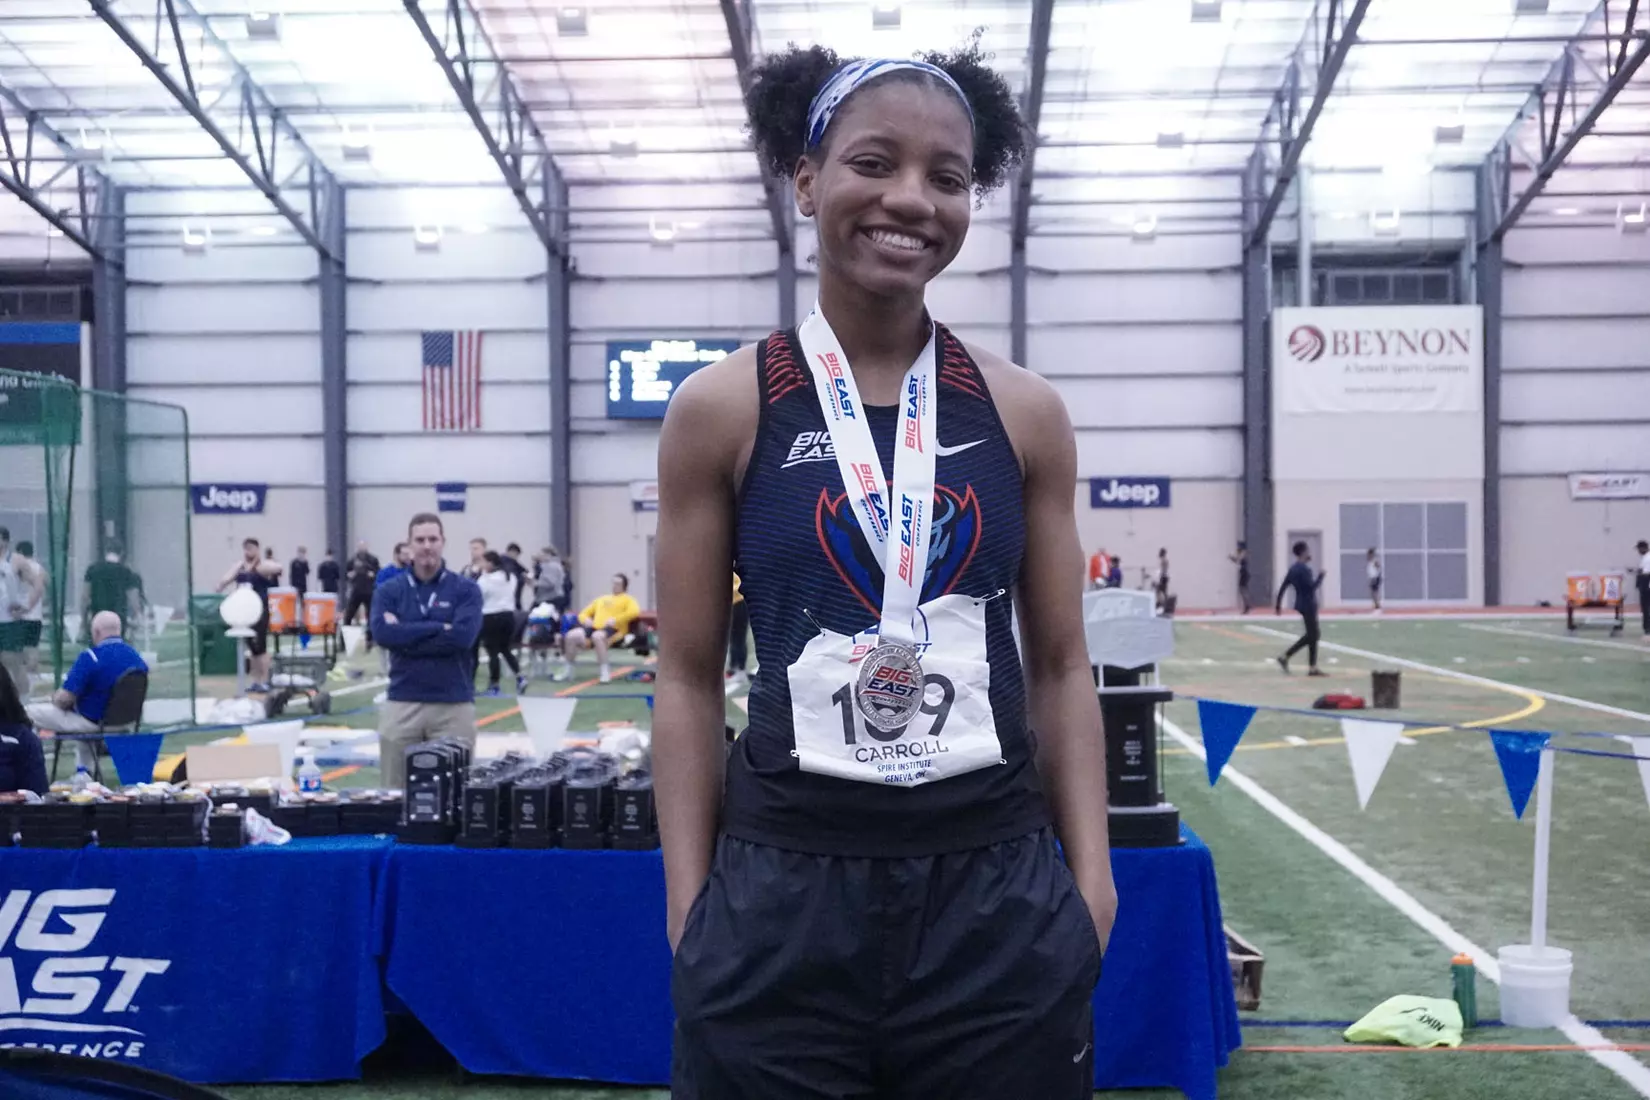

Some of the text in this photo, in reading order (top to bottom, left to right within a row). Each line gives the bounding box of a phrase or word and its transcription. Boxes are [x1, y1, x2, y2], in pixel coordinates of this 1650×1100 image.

[1331, 328, 1471, 356] BEYNON
[825, 352, 856, 420] BIG EAST
[905, 375, 919, 449] BIG EAST
[786, 445, 836, 461] EAS
[201, 486, 257, 511] Jeep
[860, 463, 888, 538] BIG EAS
[1100, 480, 1160, 505] Jeep
[898, 493, 913, 581] BIG EAST
[875, 666, 911, 683] BIG
[868, 679, 919, 697] EAST
[832, 673, 955, 745] 19
[855, 740, 949, 763] CARROLL
[877, 759, 931, 772] SPIRE INSTITUTE
[0, 888, 116, 951] IG
